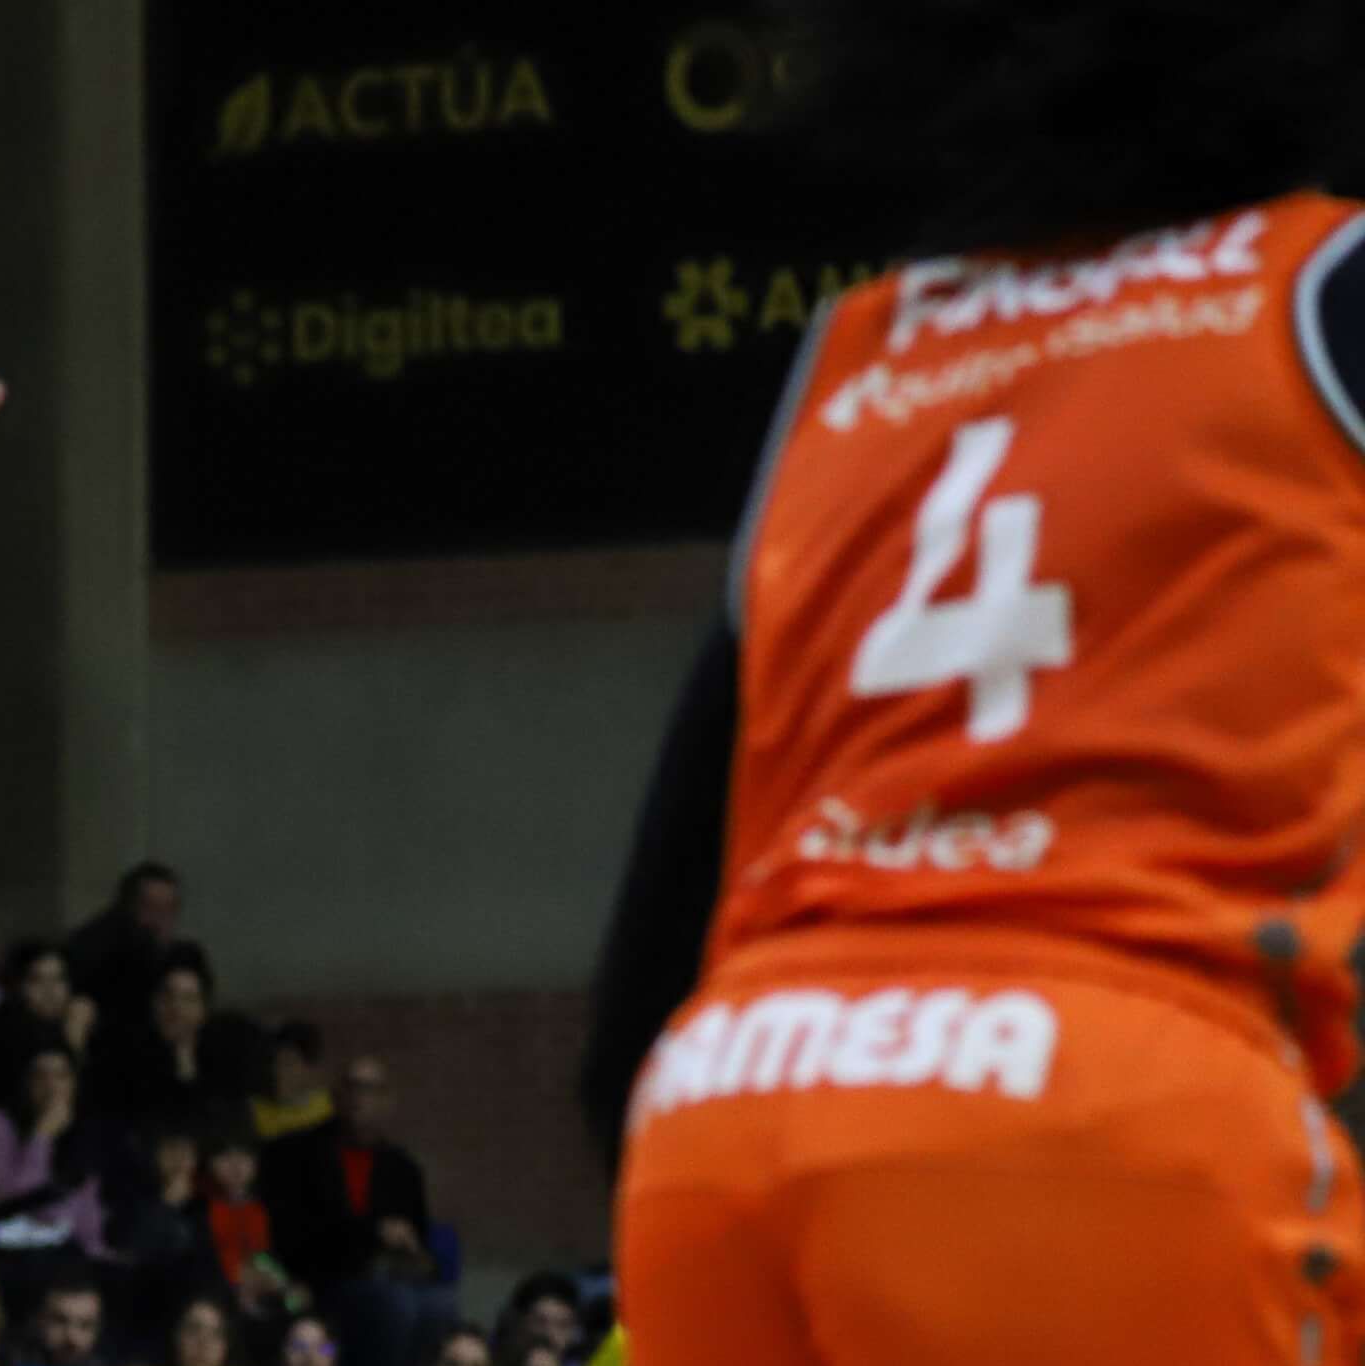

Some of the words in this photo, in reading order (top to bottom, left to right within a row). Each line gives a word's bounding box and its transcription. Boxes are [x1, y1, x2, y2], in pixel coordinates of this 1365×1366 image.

[279, 46, 552, 139] ACTÚA
[292, 291, 564, 379] Digiltea
[849, 414, 1072, 743] 4
